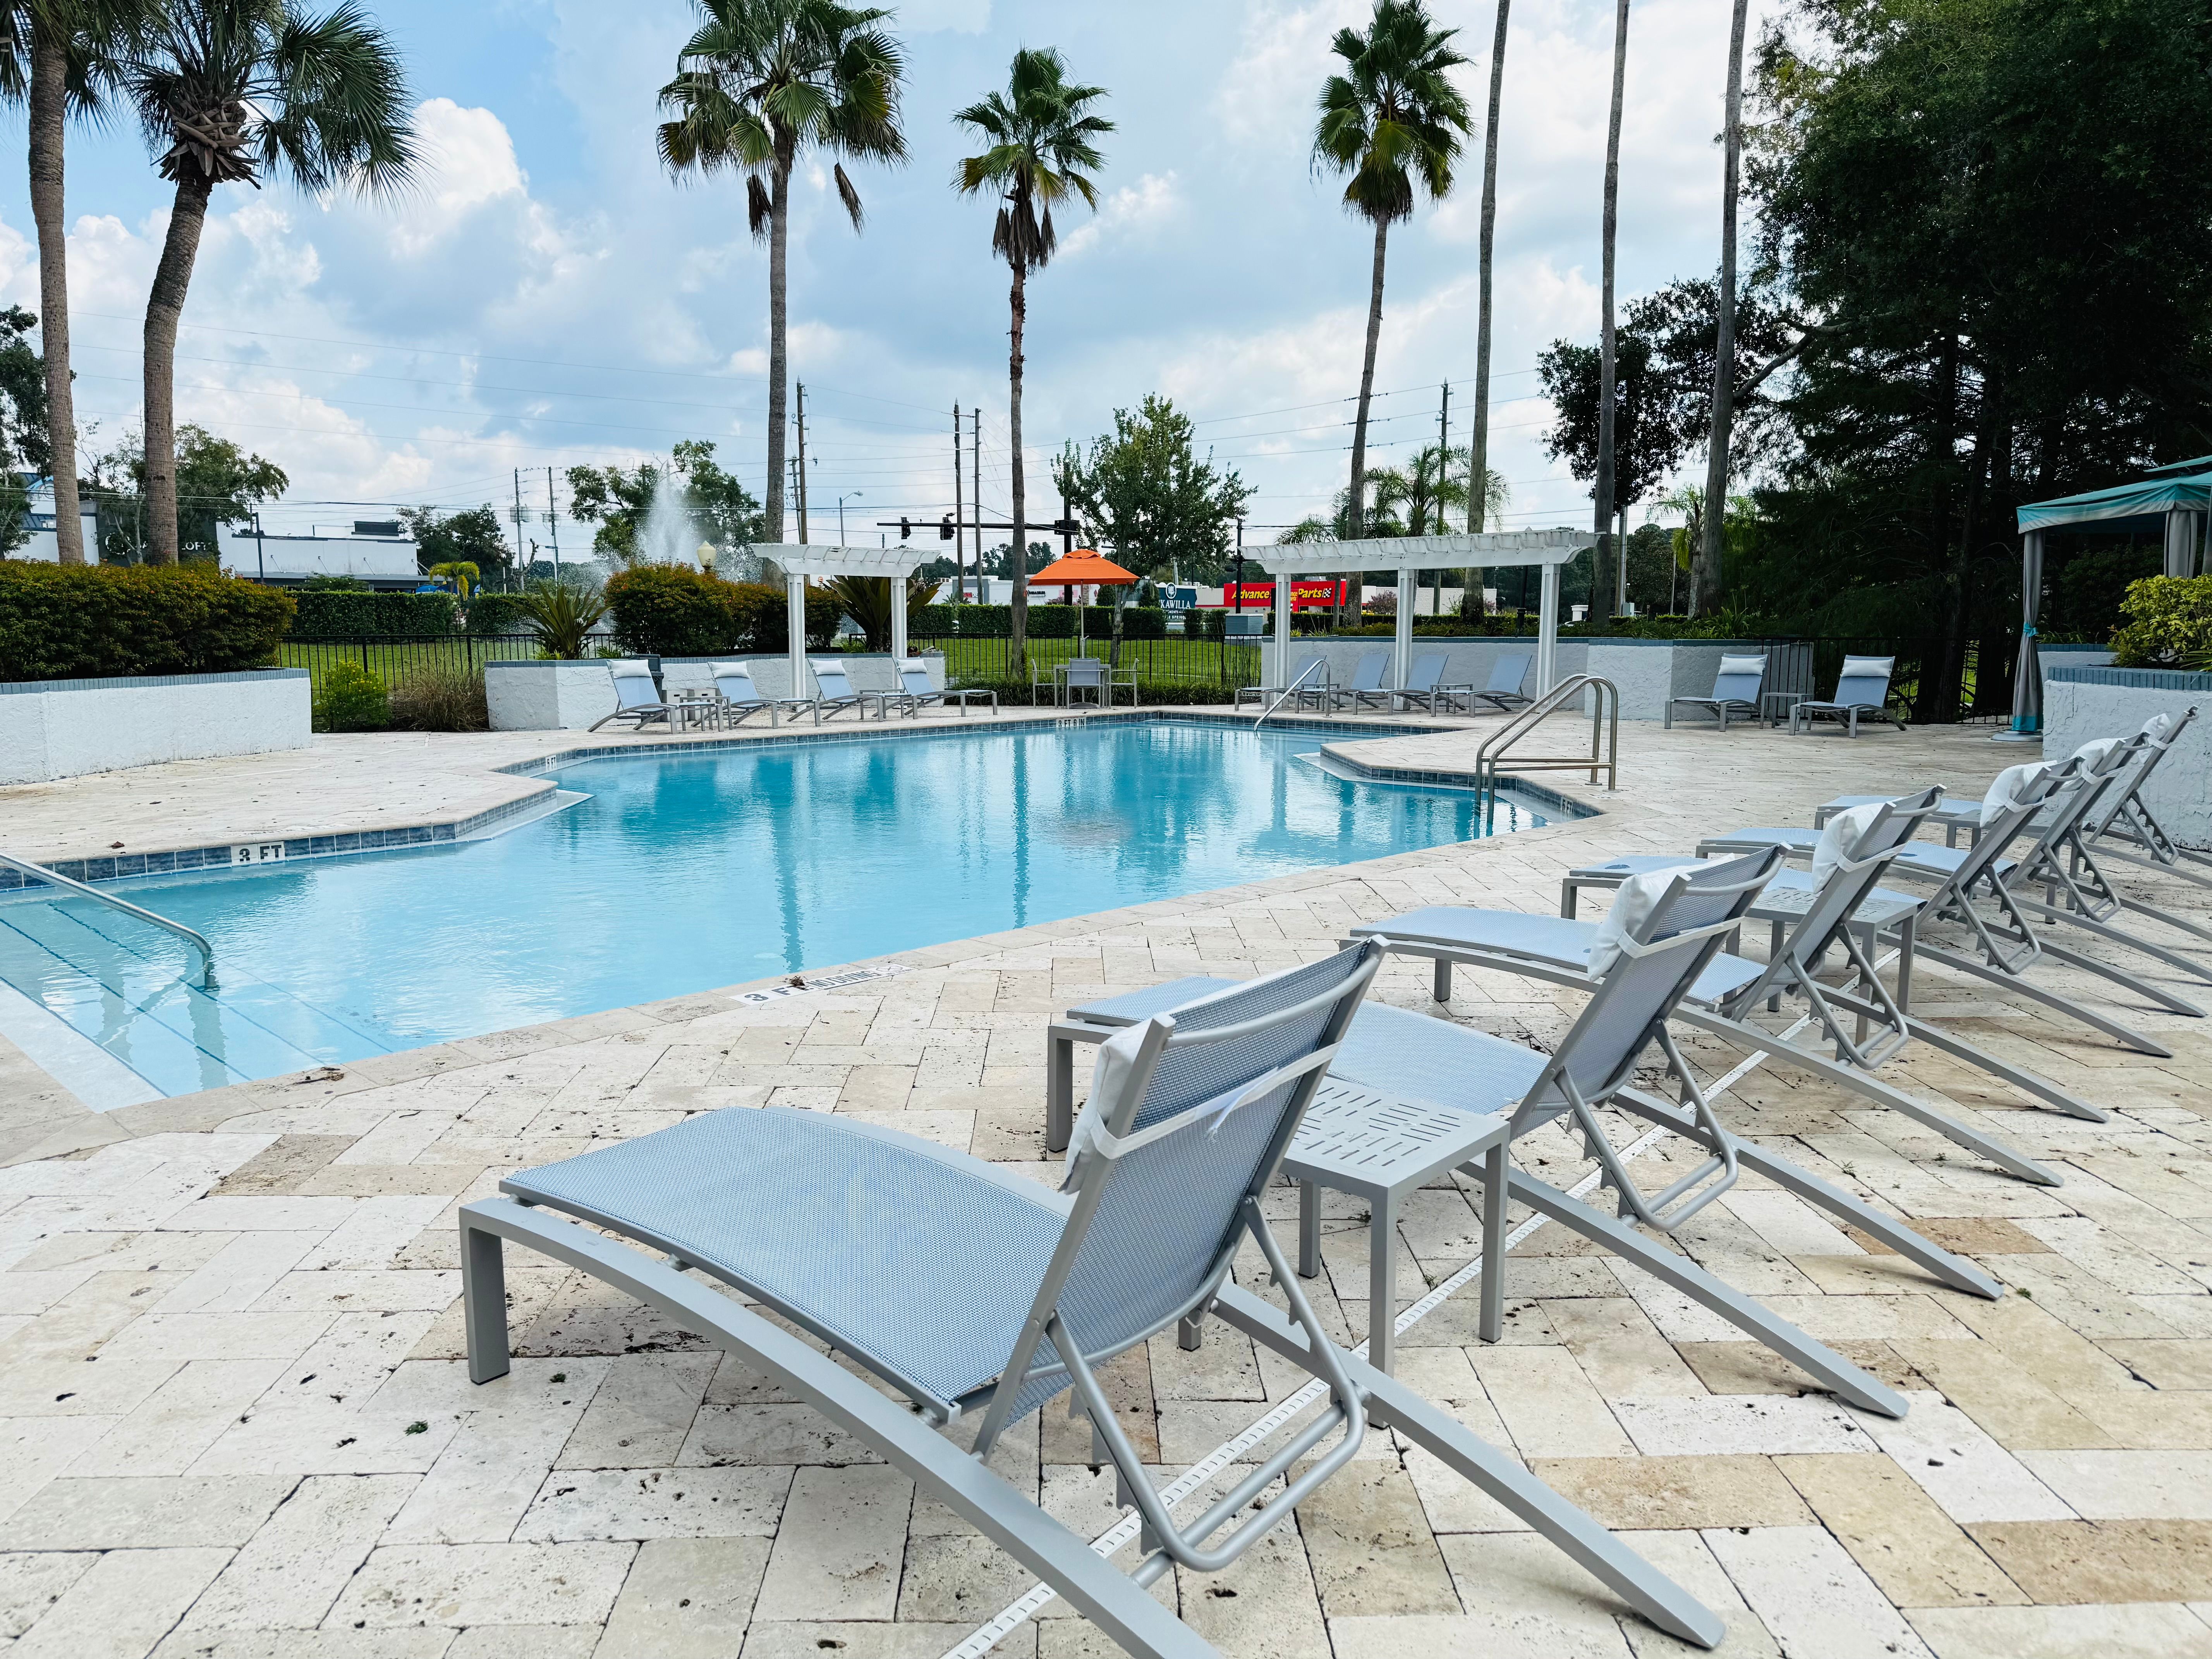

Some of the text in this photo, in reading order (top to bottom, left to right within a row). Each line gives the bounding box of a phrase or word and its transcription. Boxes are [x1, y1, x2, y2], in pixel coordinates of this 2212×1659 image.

[182, 542, 206, 550] OFT
[1231, 589, 1270, 599] Advance
[1298, 588, 1322, 598] Parts
[1159, 600, 1190, 609] KAWILLA
[239, 845, 282, 862] 3 FT
[806, 979, 836, 988] NO
[825, 970, 883, 983] DIVING
